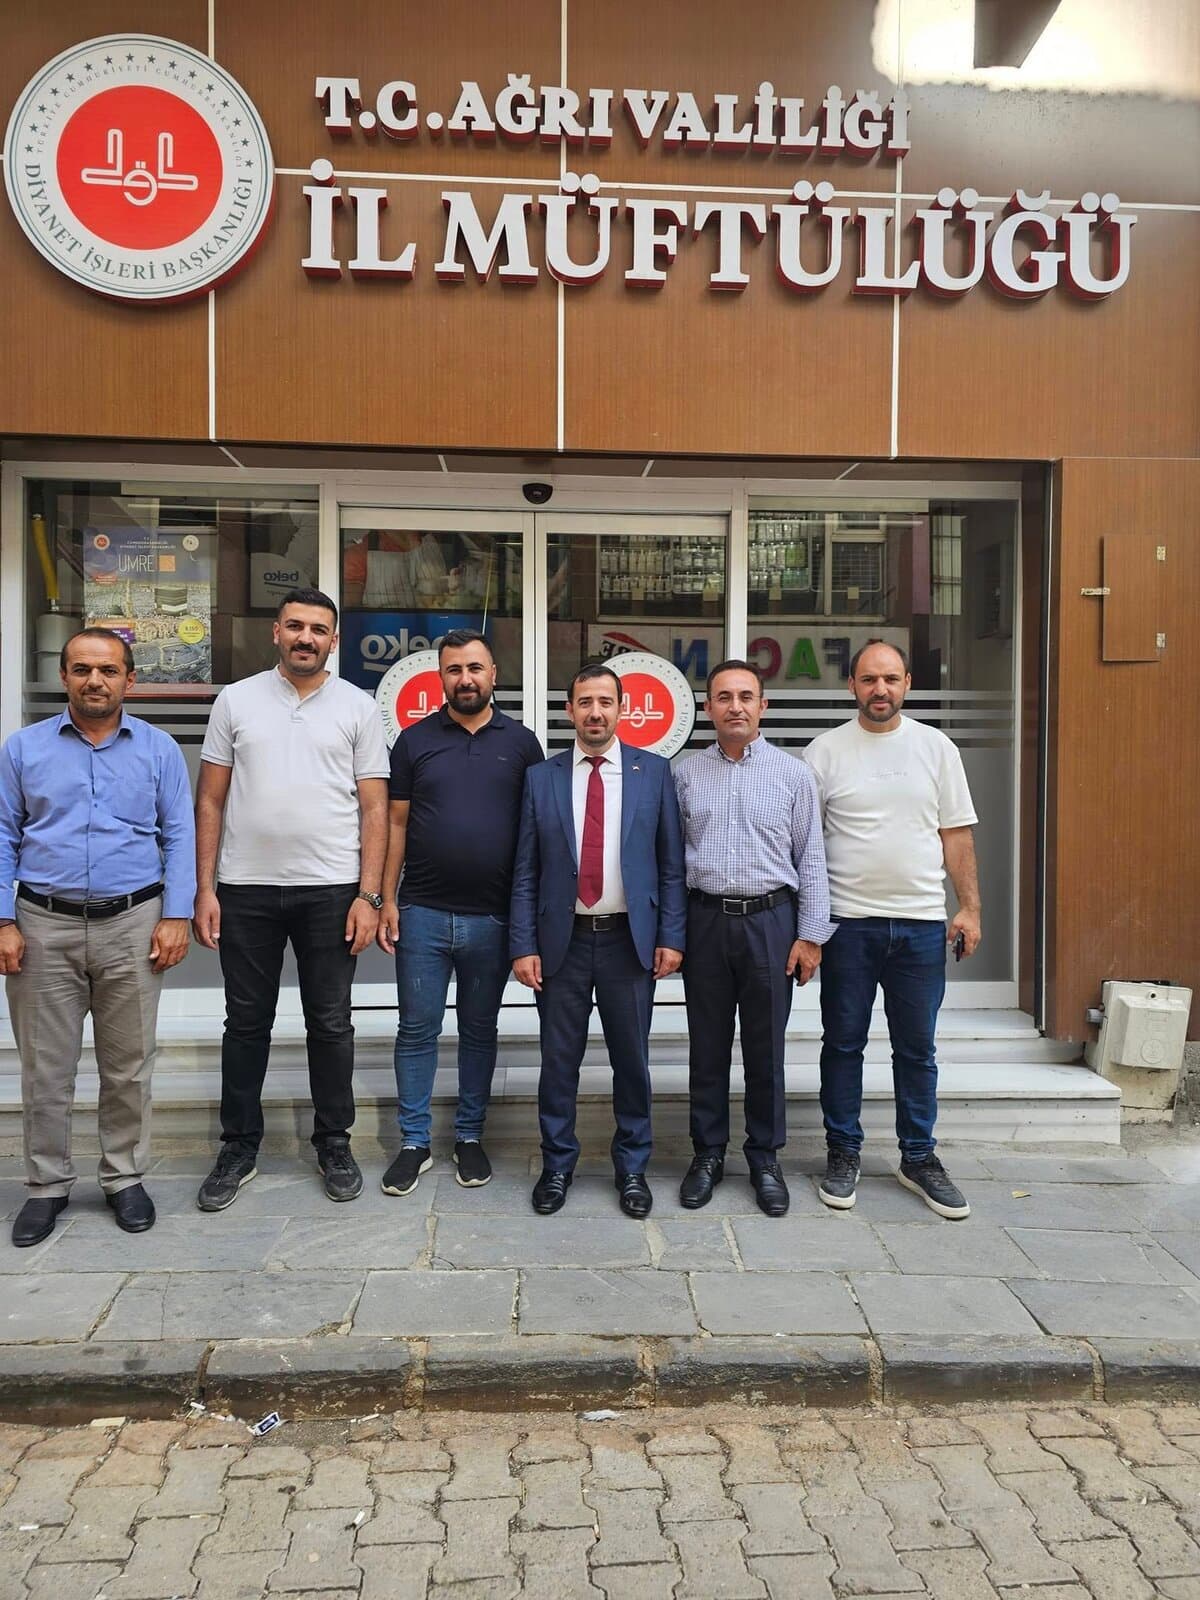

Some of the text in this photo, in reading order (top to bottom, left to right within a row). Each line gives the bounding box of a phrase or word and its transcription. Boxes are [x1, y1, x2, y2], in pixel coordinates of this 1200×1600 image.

[315, 73, 911, 152] T.C. AĞRI VALİLİĞİ
[25, 163, 254, 281] DİYANET İŞLERİ BAŞKANLIĞI
[301, 158, 1138, 296] İL MÜFTÜLÜĞÜ
[118, 554, 155, 573] UMRE
